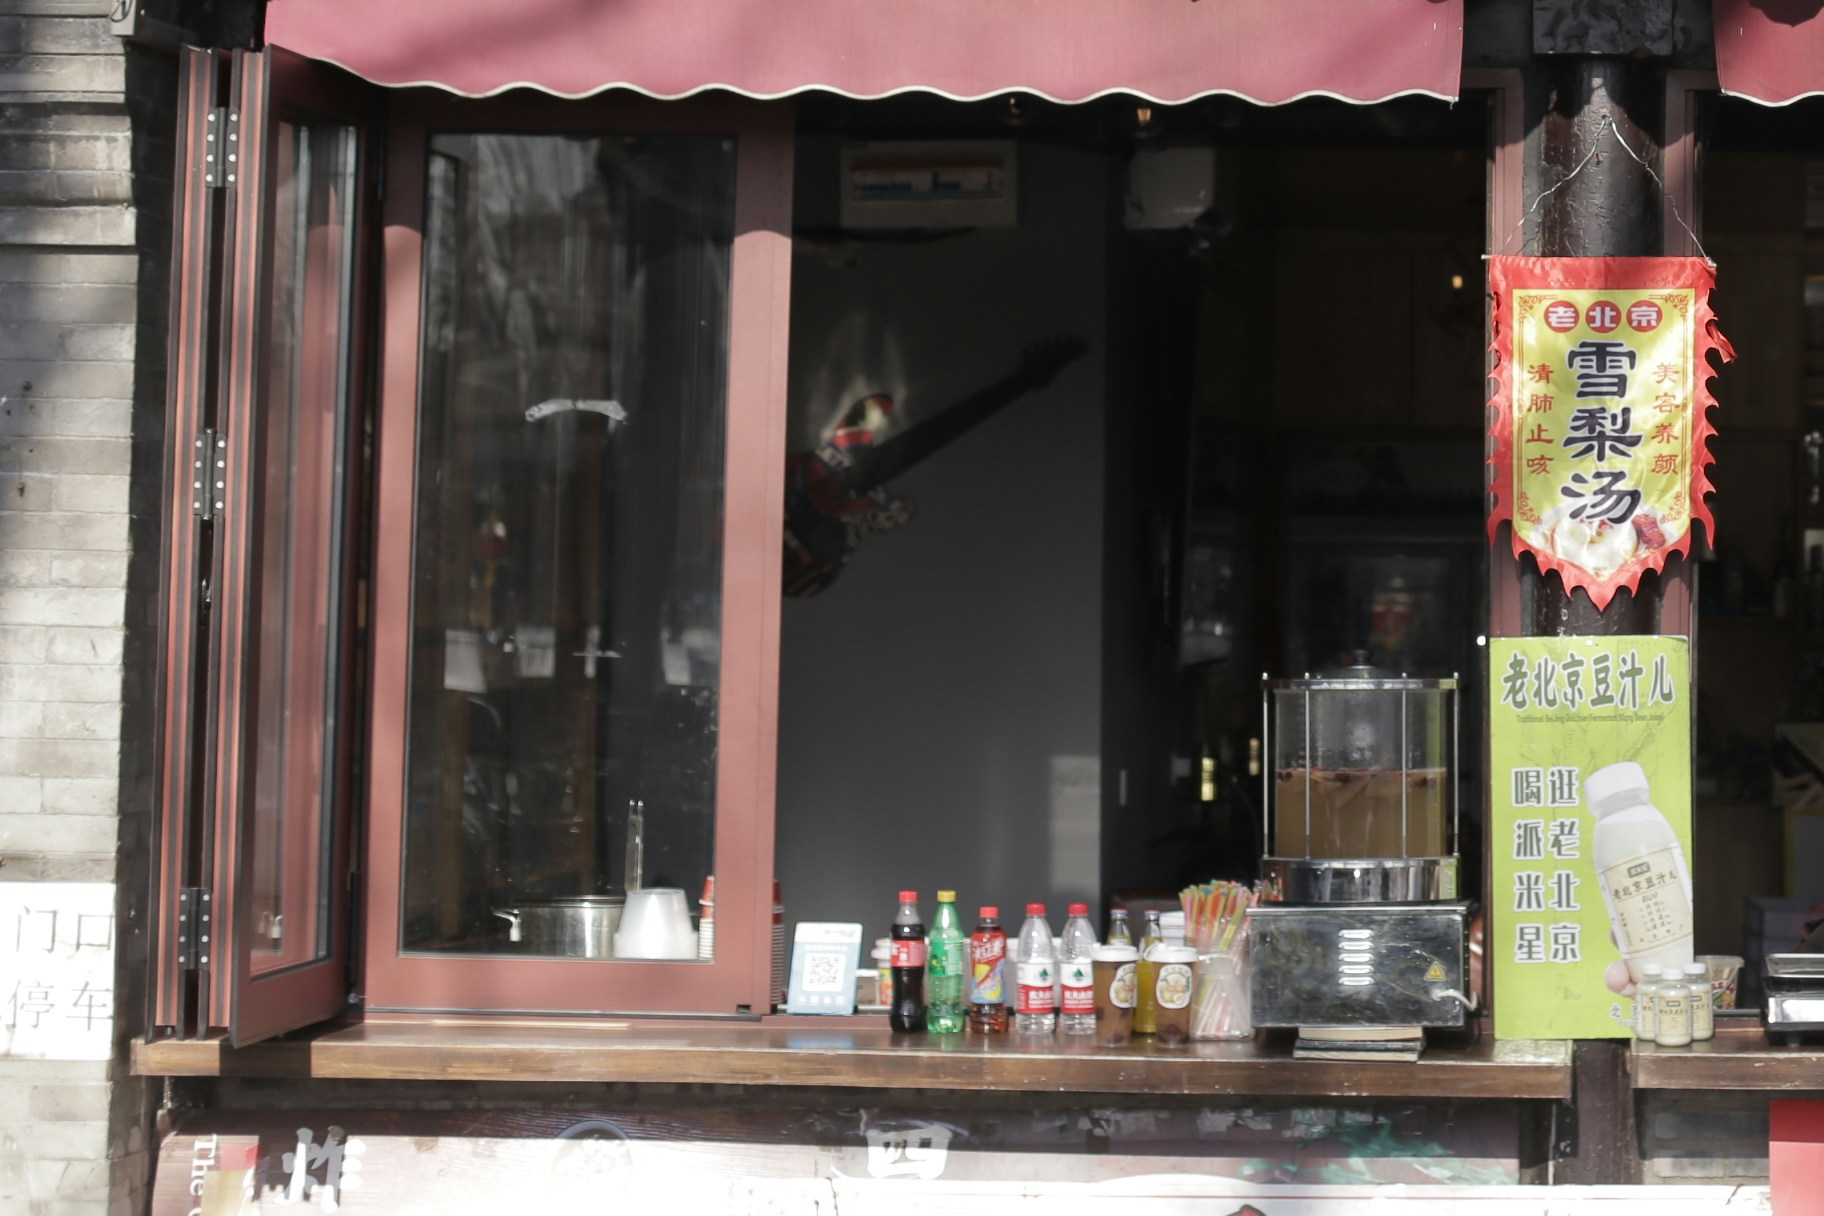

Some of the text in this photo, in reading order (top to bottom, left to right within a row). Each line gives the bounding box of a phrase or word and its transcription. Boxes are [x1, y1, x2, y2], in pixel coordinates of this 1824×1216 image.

[1547, 305, 1659, 328] 老北京
[1526, 364, 1554, 475] 清肺止咳
[1561, 341, 1642, 523] 雪梨汤
[1651, 363, 1680, 474] 美容养颜
[1502, 651, 1675, 709] 老北京豆汁儿
[1514, 770, 1543, 961] 喝派米星
[1549, 769, 1579, 961] 逛老北京
[16, 904, 116, 955] 门口
[188, 1134, 218, 1196] The
